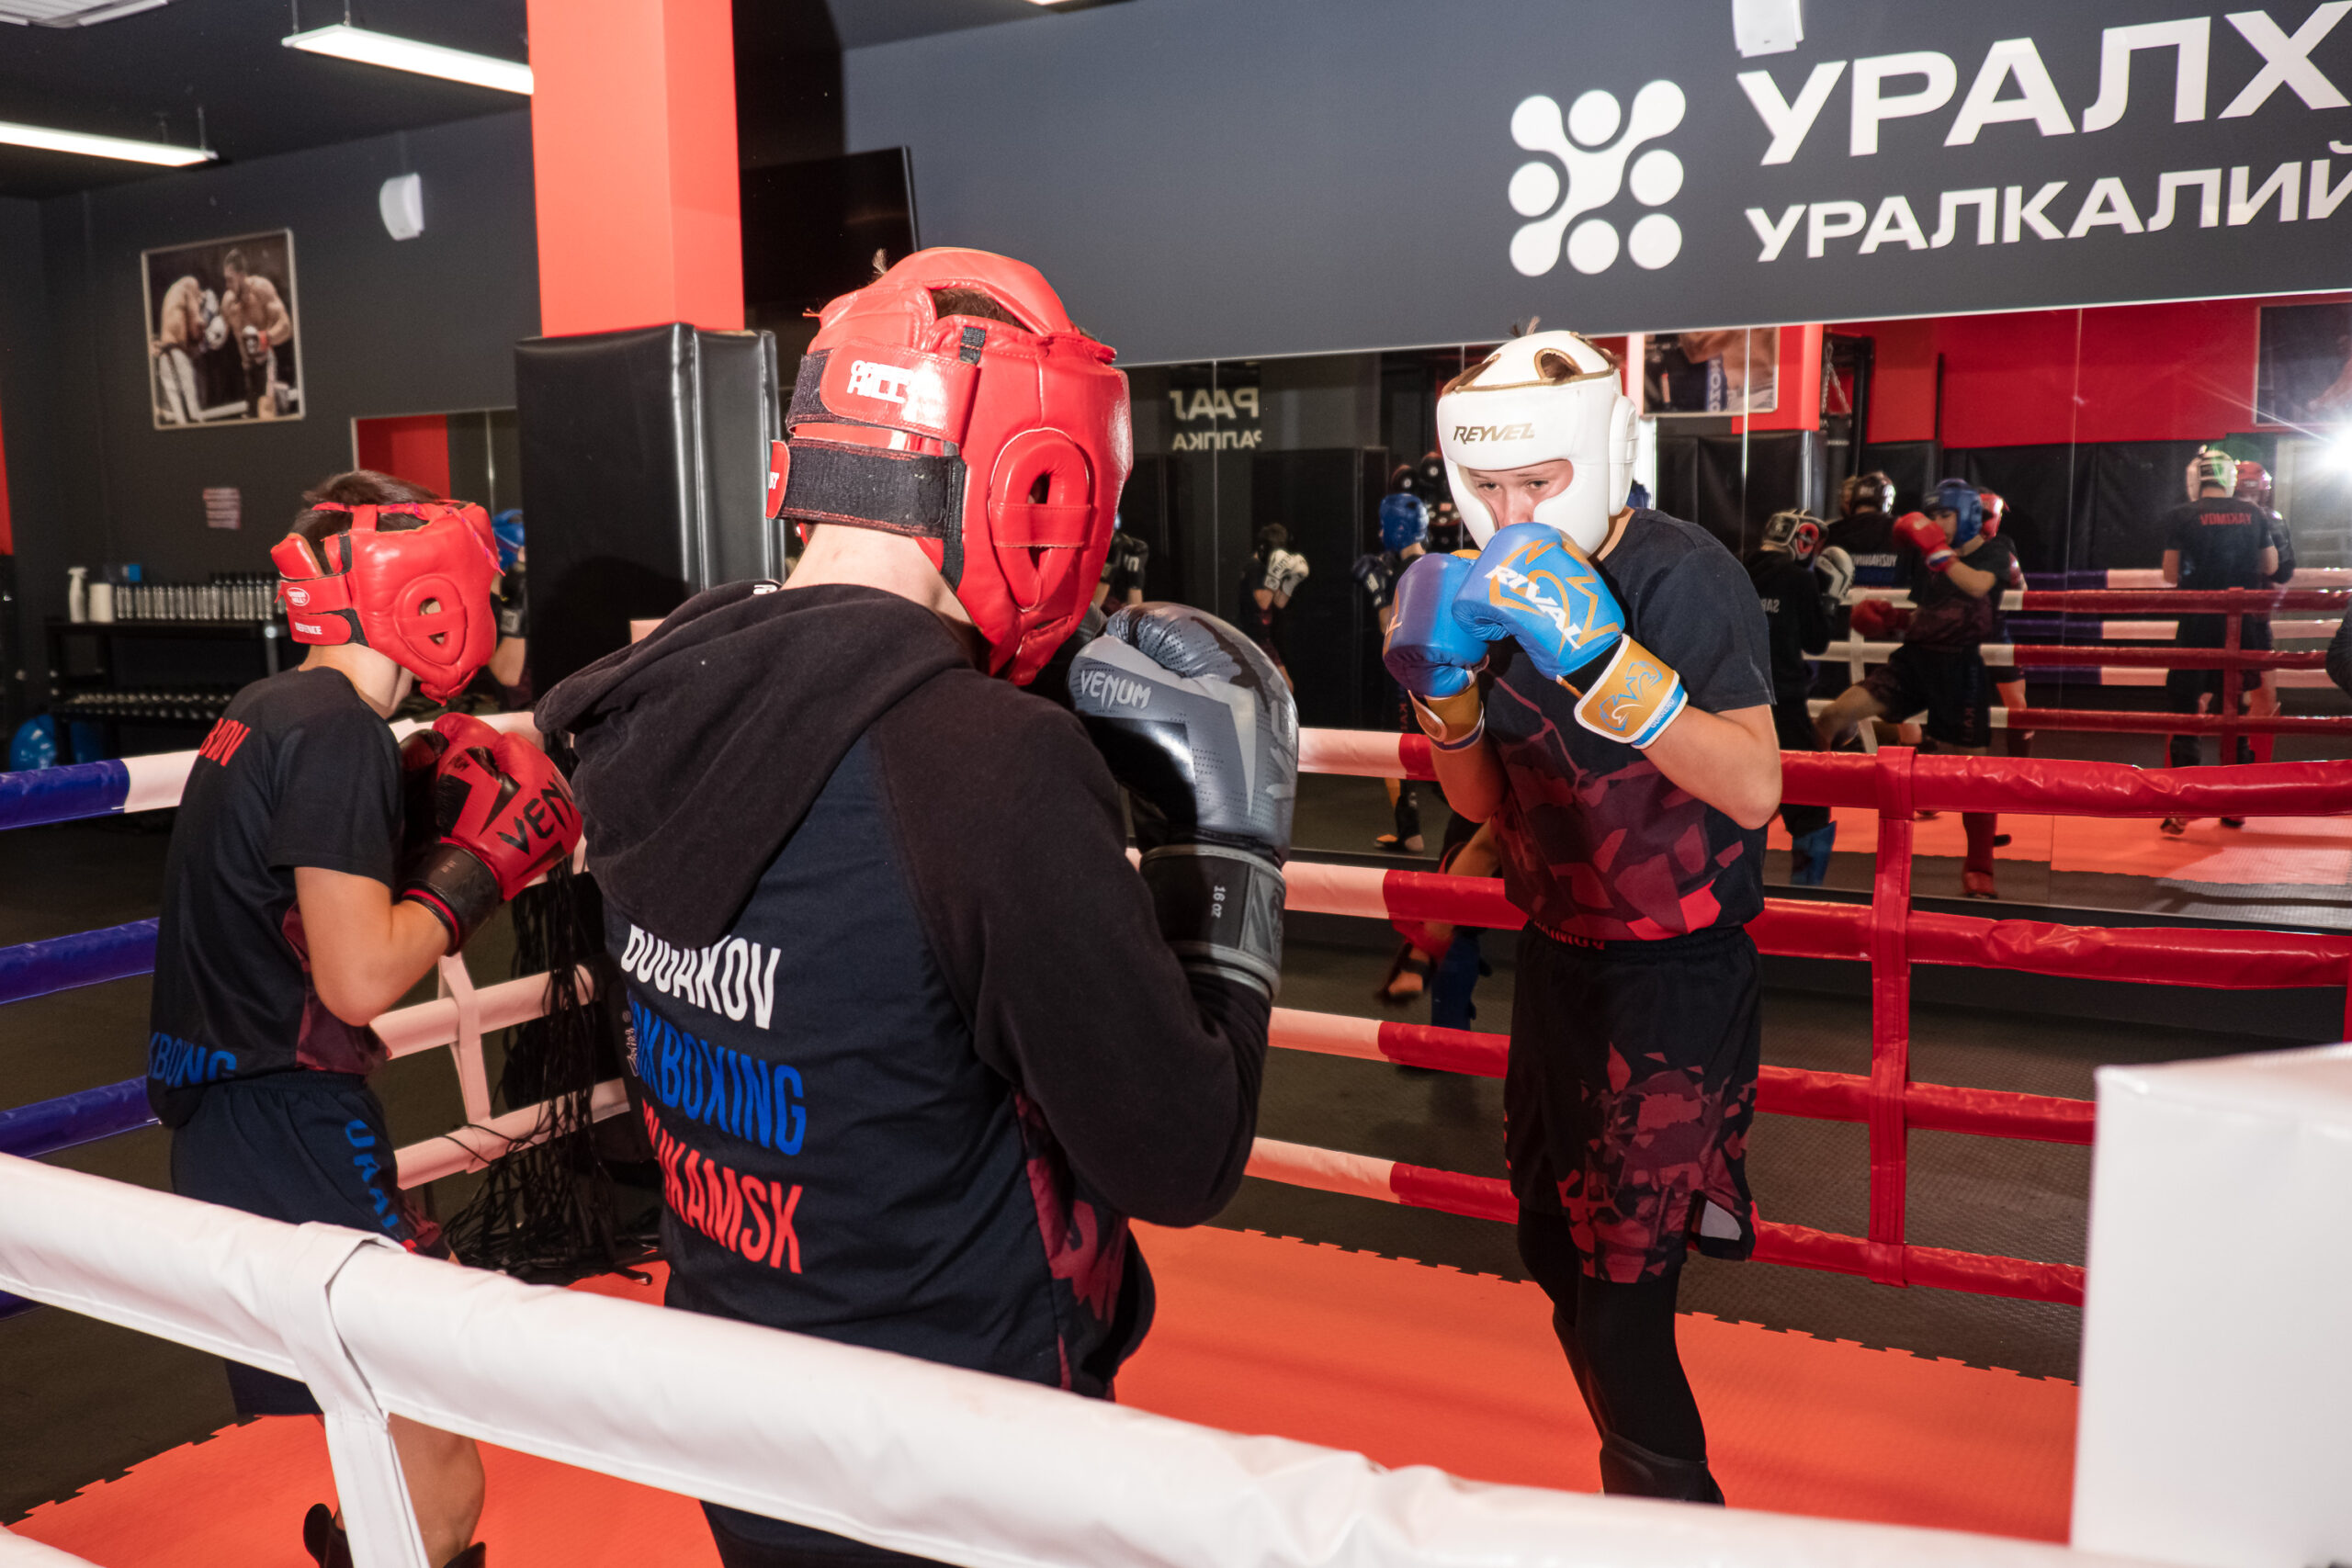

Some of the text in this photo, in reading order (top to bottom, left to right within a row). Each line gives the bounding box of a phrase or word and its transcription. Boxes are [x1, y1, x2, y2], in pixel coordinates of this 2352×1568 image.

[1737, 0, 2352, 166] УРАЛХ
[1453, 423, 1535, 445] REYVEL
[1484, 565, 1582, 649] RIVAL
[1080, 670, 1151, 709] VENUM
[1213, 886, 1227, 901] 16
